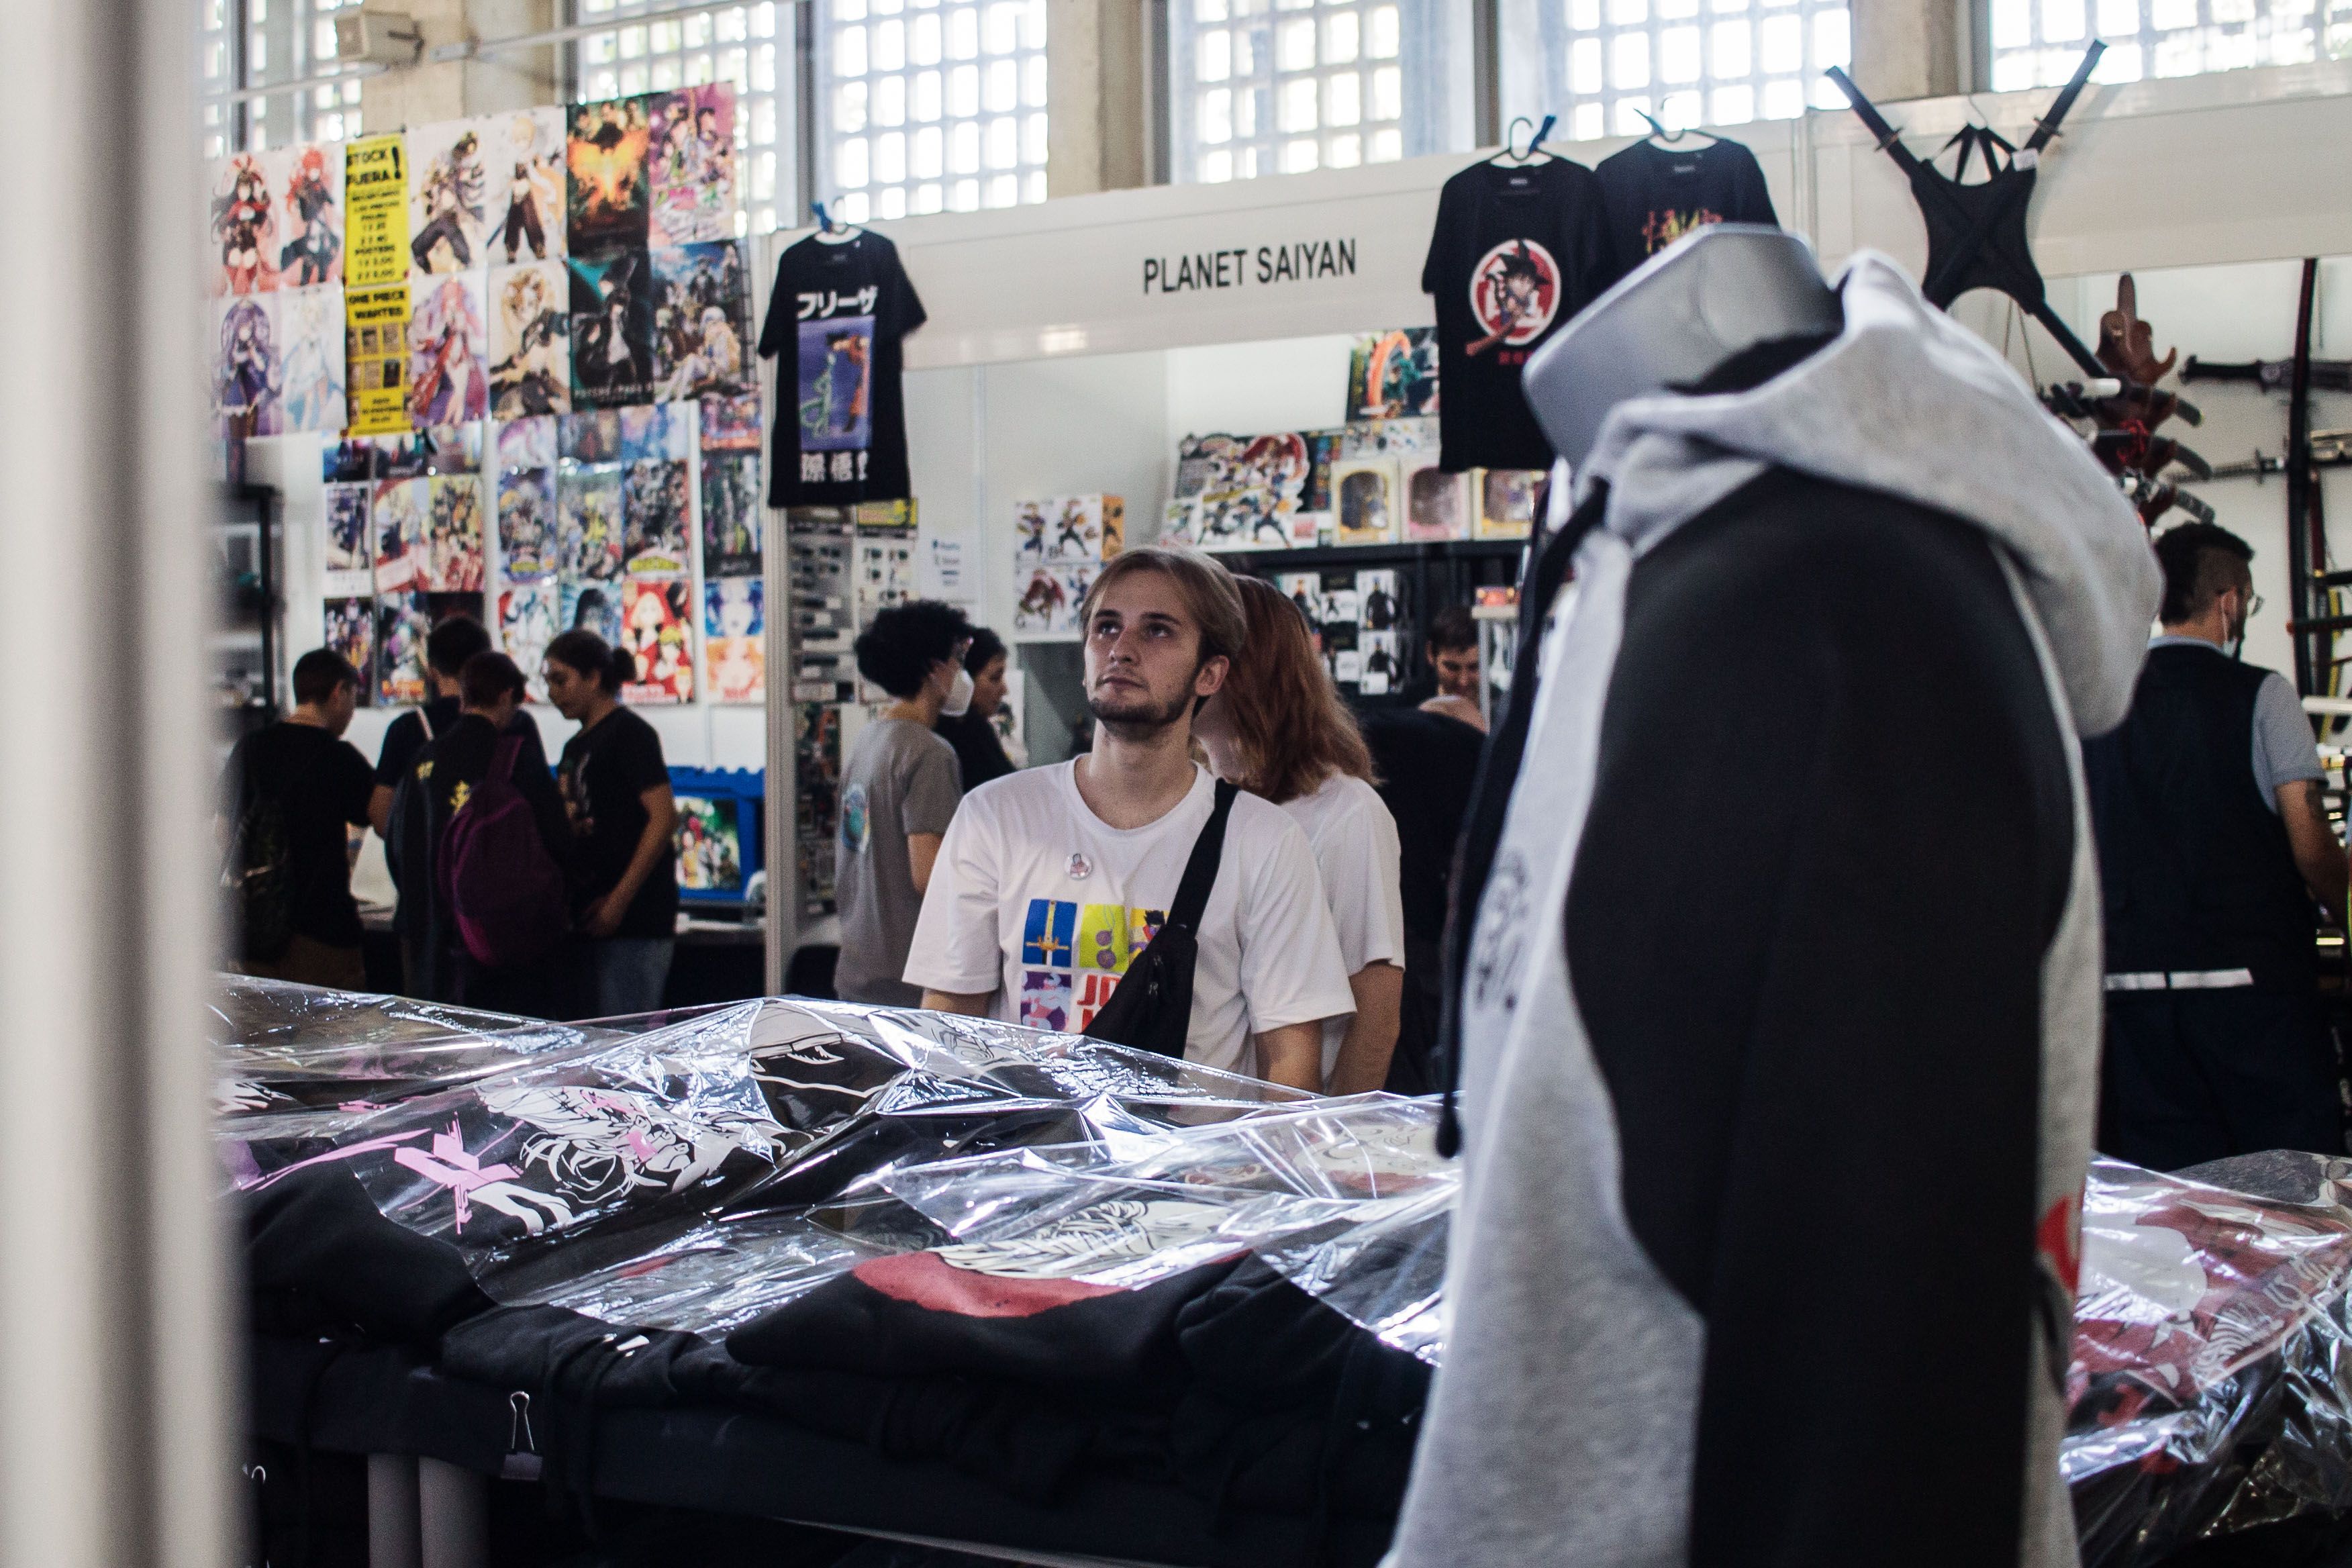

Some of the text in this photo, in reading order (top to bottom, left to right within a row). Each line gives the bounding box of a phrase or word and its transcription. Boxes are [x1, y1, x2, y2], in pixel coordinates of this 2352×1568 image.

[1143, 238, 1355, 295] PLANET SAIYAN
[796, 284, 879, 320] フリーザ
